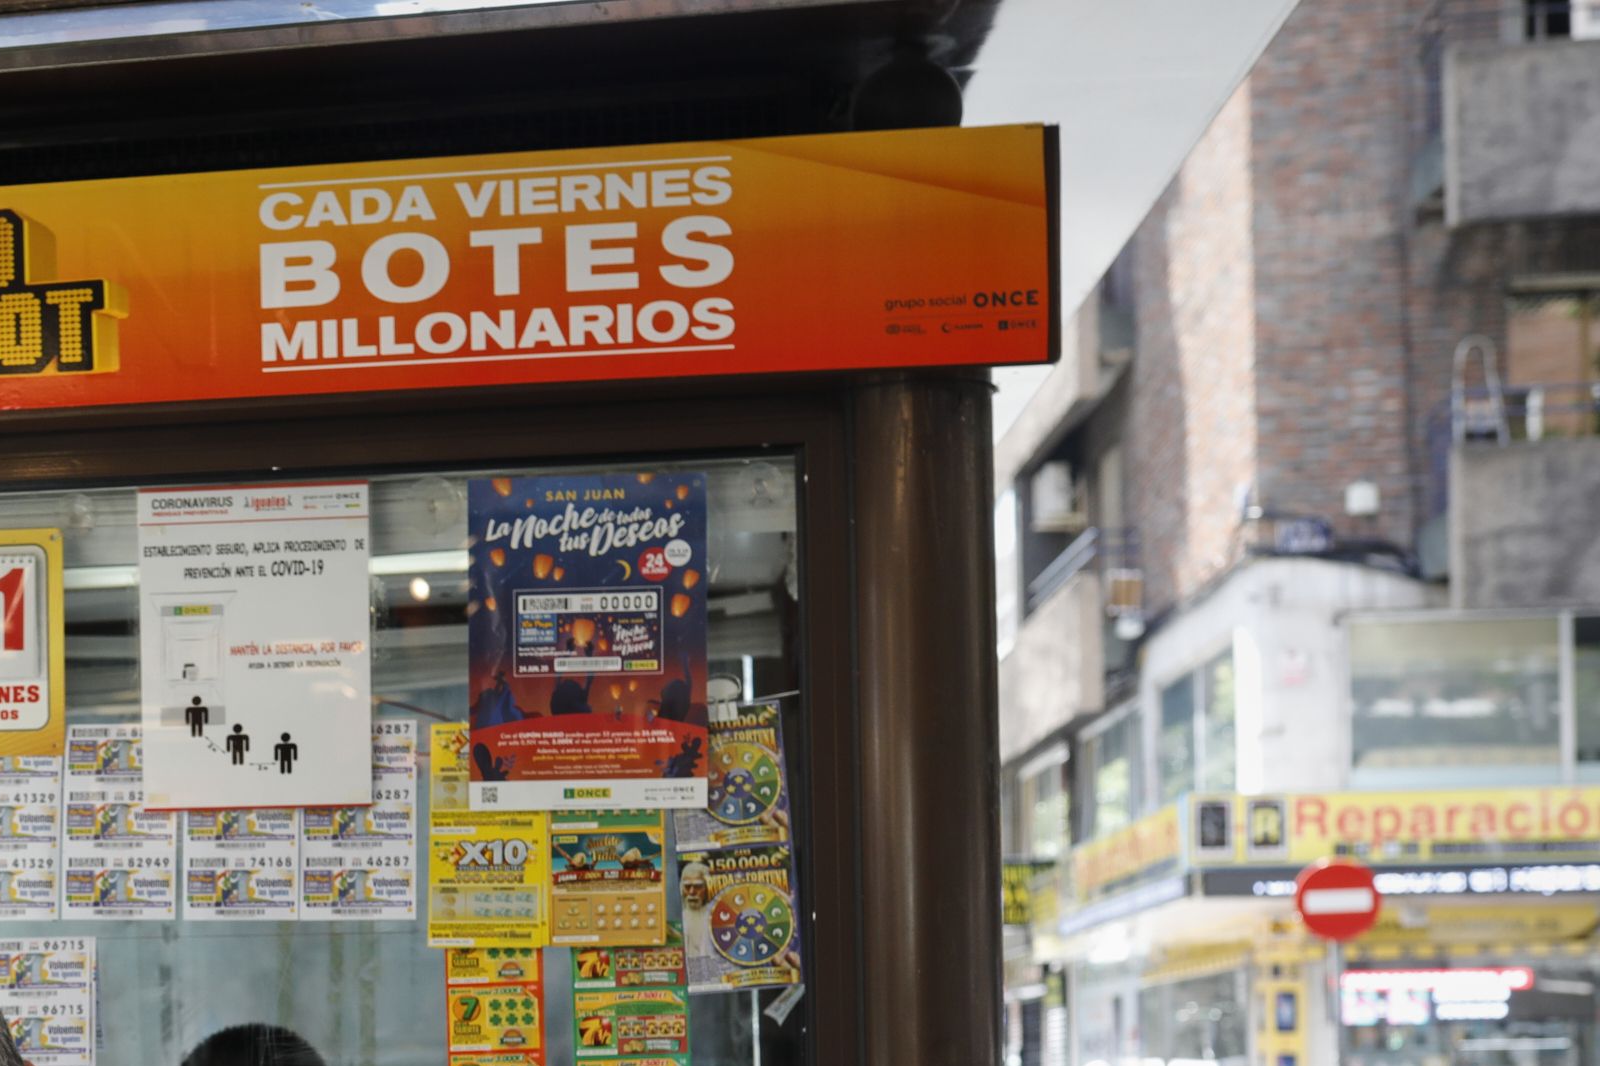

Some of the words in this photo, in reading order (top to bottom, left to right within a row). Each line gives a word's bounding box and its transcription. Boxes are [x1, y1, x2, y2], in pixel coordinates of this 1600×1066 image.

[259, 185, 437, 231] CADA
[455, 165, 733, 218] VIERNES
[260, 215, 736, 310] BOTES
[973, 289, 1039, 308] ONCE
[262, 297, 736, 362] MILLONARIOS
[546, 490, 577, 502] SAN
[583, 488, 625, 500] JUAN
[151, 496, 234, 510] CORONAVIRUS
[485, 519, 511, 542] La
[510, 502, 599, 550] Noche
[616, 506, 653, 525] todos
[559, 532, 590, 552] tus
[589, 512, 686, 557] Deseos
[271, 558, 325, 577] COVID-19
[645, 553, 665, 568] 24
[372, 724, 410, 734] 6287
[14, 793, 55, 803] 41329
[372, 789, 410, 800] 6287
[577, 789, 609, 799] ONCE
[1293, 788, 1600, 855] Reparació
[458, 838, 528, 867] X10
[12, 858, 53, 868] 41329
[128, 857, 170, 868] 82949
[250, 857, 293, 868] 74168
[366, 857, 410, 867] 46287
[43, 941, 85, 951] 96715
[42, 1005, 84, 1015] 96715
